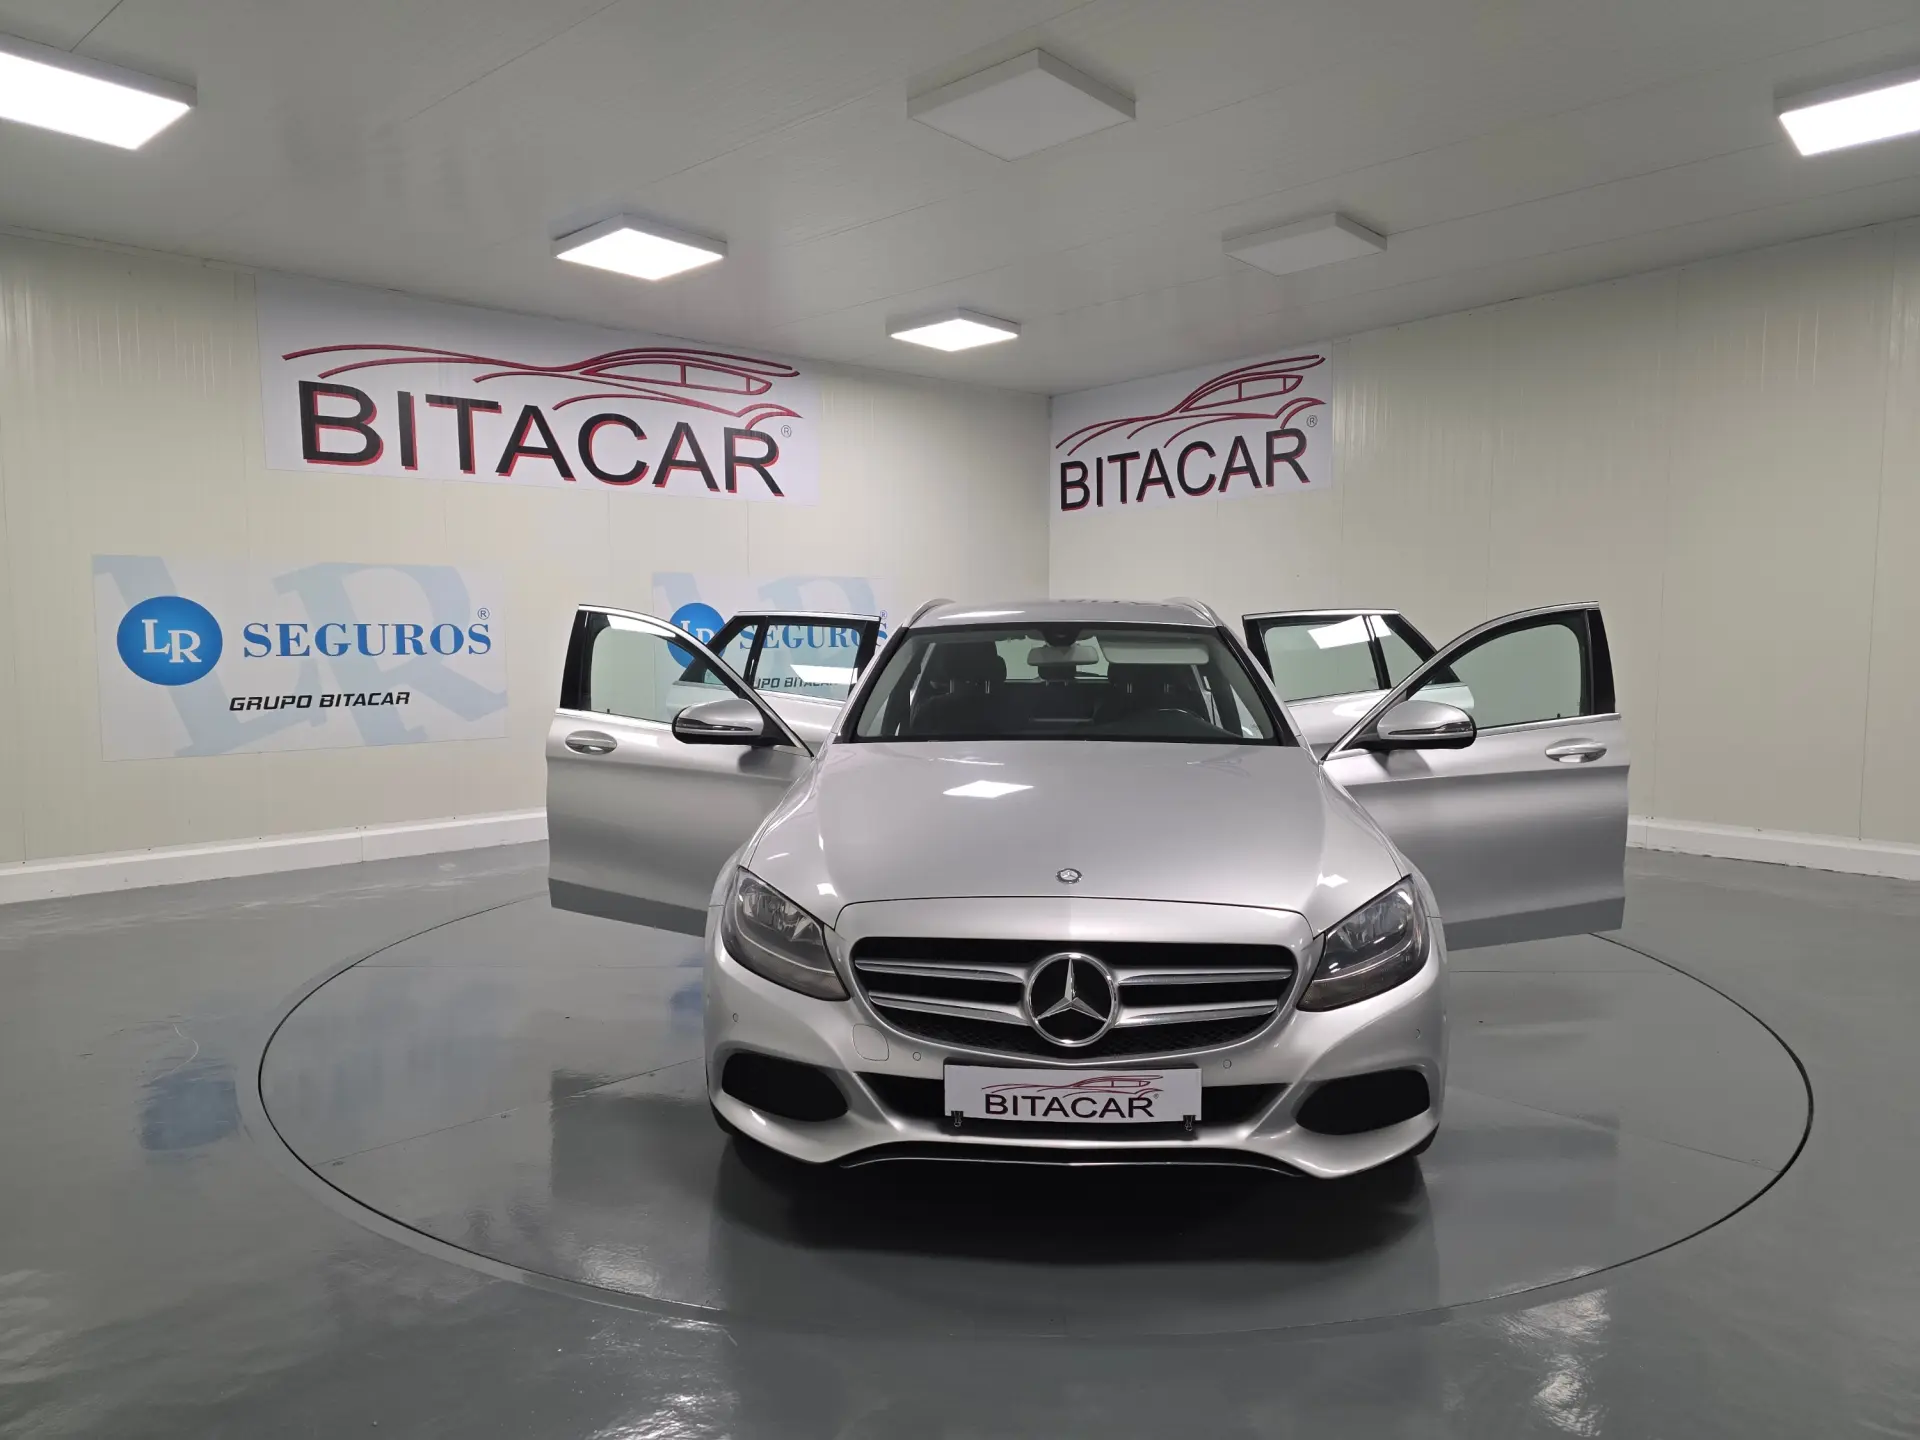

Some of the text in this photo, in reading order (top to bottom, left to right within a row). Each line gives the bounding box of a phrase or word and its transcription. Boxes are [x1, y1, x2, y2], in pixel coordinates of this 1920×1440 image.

[298, 380, 785, 498] BITACAR
[1060, 428, 1311, 511] BITACAR
[141, 618, 492, 664] LR SEGUROS
[229, 691, 411, 711] GRUPO BITACAR
[984, 1093, 1155, 1119] BITACAR
